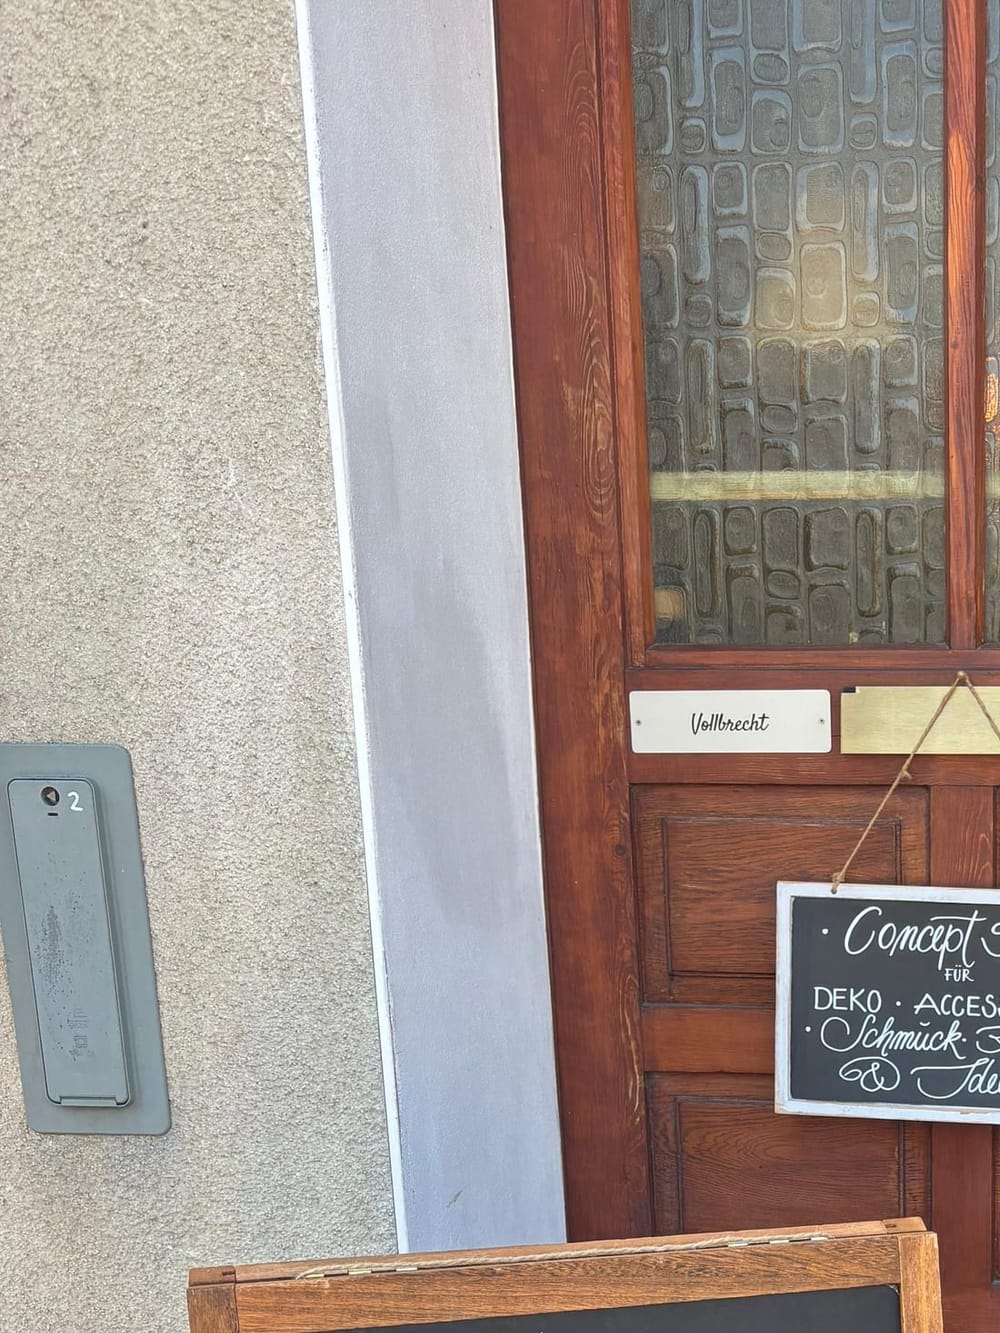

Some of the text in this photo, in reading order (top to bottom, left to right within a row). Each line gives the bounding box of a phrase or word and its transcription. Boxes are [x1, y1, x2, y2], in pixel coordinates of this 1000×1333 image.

[691, 712, 769, 735] Vollbrecht
[67, 791, 84, 812] 2
[843, 905, 988, 970] Concept
[944, 964, 975, 983] FÜR
[813, 986, 882, 1013] DEKO
[838, 1056, 901, 1093] &
